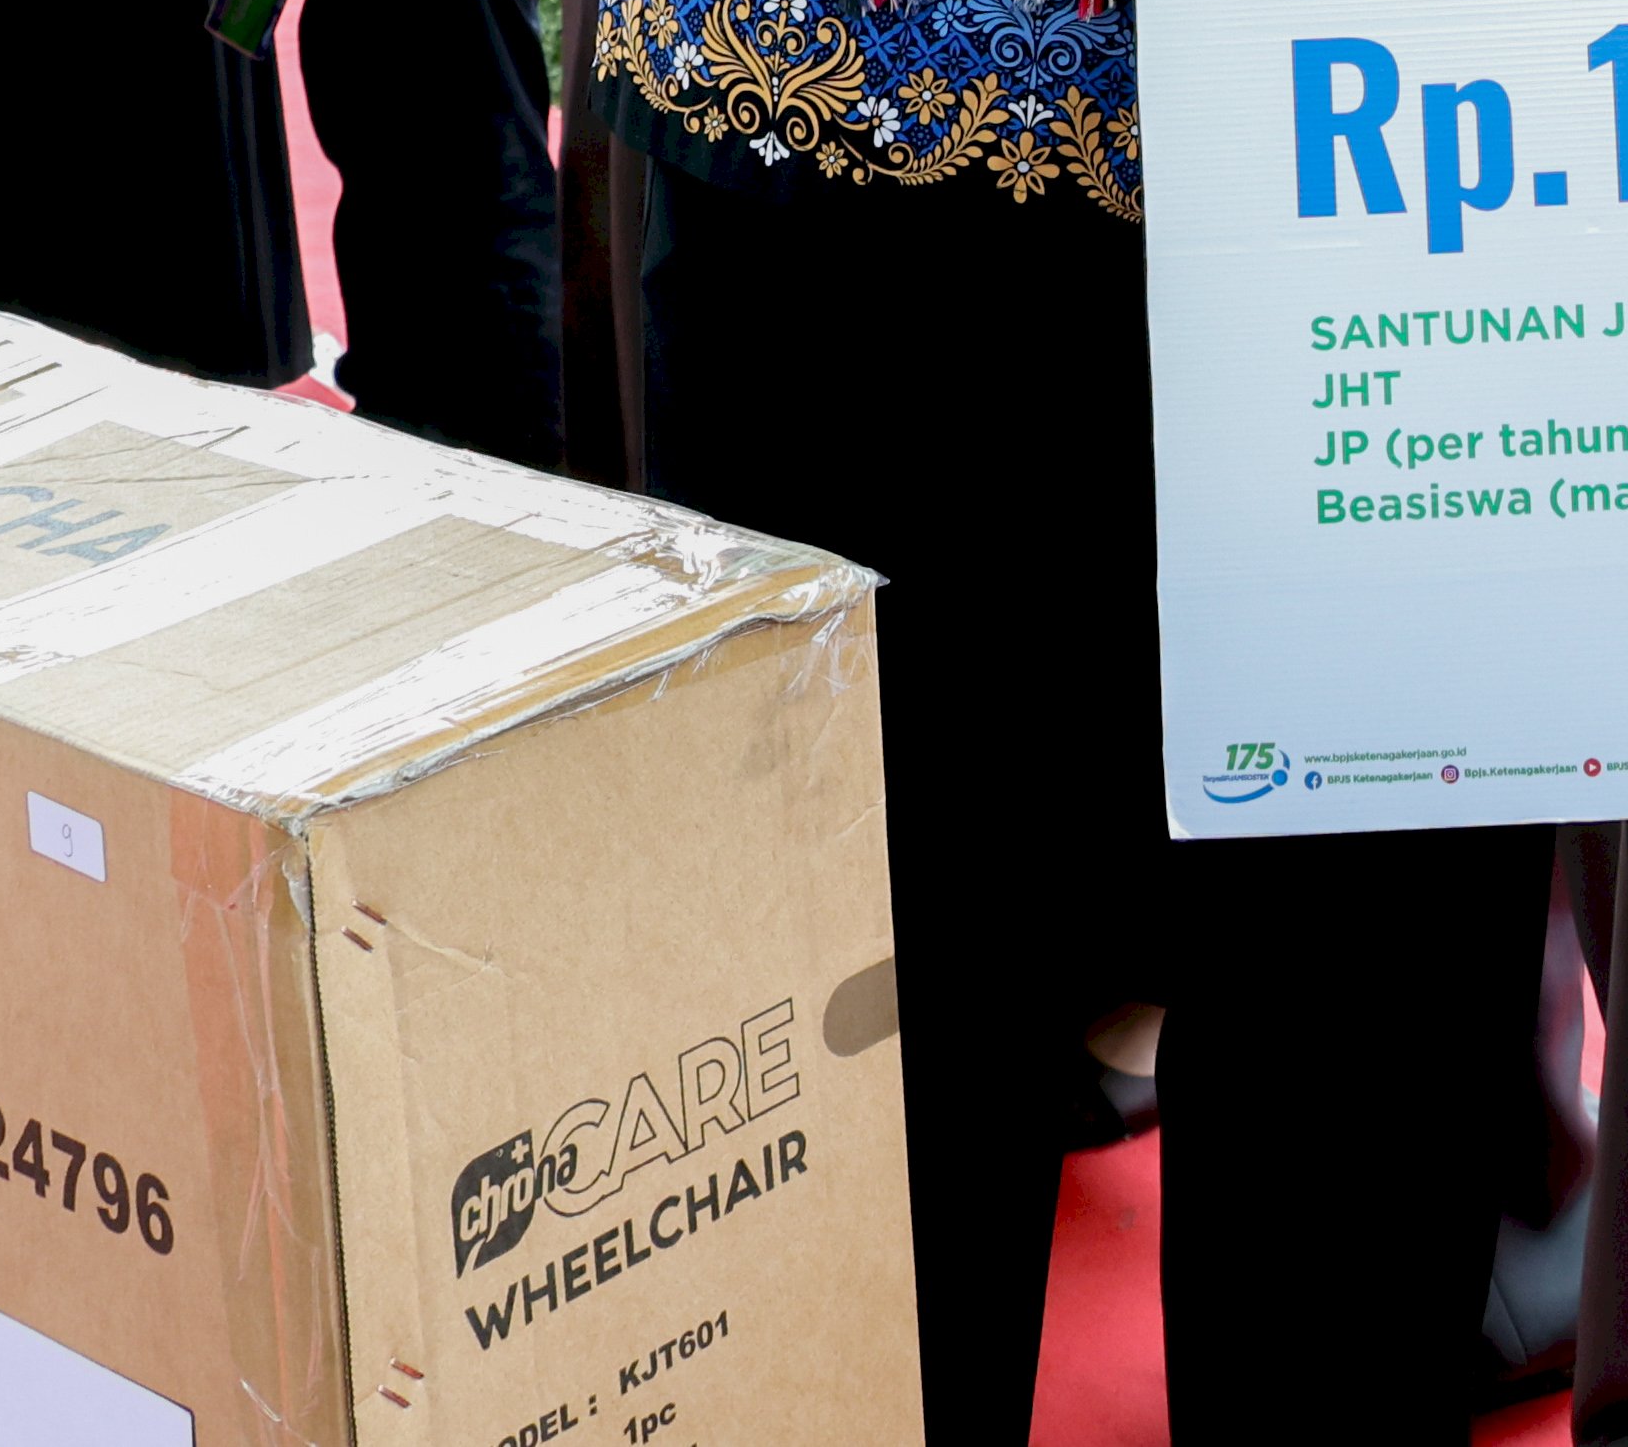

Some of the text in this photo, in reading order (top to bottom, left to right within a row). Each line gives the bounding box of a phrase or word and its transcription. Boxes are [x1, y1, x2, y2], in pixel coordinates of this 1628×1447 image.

[1311, 303, 1585, 352] SANTUNAN
[1311, 370, 1402, 410] JHT
[1314, 429, 1370, 467] JP
[1385, 427, 1484, 470] (per
[1316, 487, 1532, 525] Beasiswa
[1226, 741, 1276, 771] 175
[1304, 747, 1467, 765] www.bpjsketenagakerjaan.go.id
[1327, 775, 1350, 785] BPJS
[1352, 771, 1433, 784] Ketenagakerjaan
[541, 997, 801, 1218] CARE
[458, 1142, 578, 1247] chrona
[464, 1129, 808, 1351] WHEELCHAIR
[488, 1403, 579, 1447] ODEL
[618, 1310, 729, 1395] KJT601
[623, 1402, 677, 1446] 1pc
